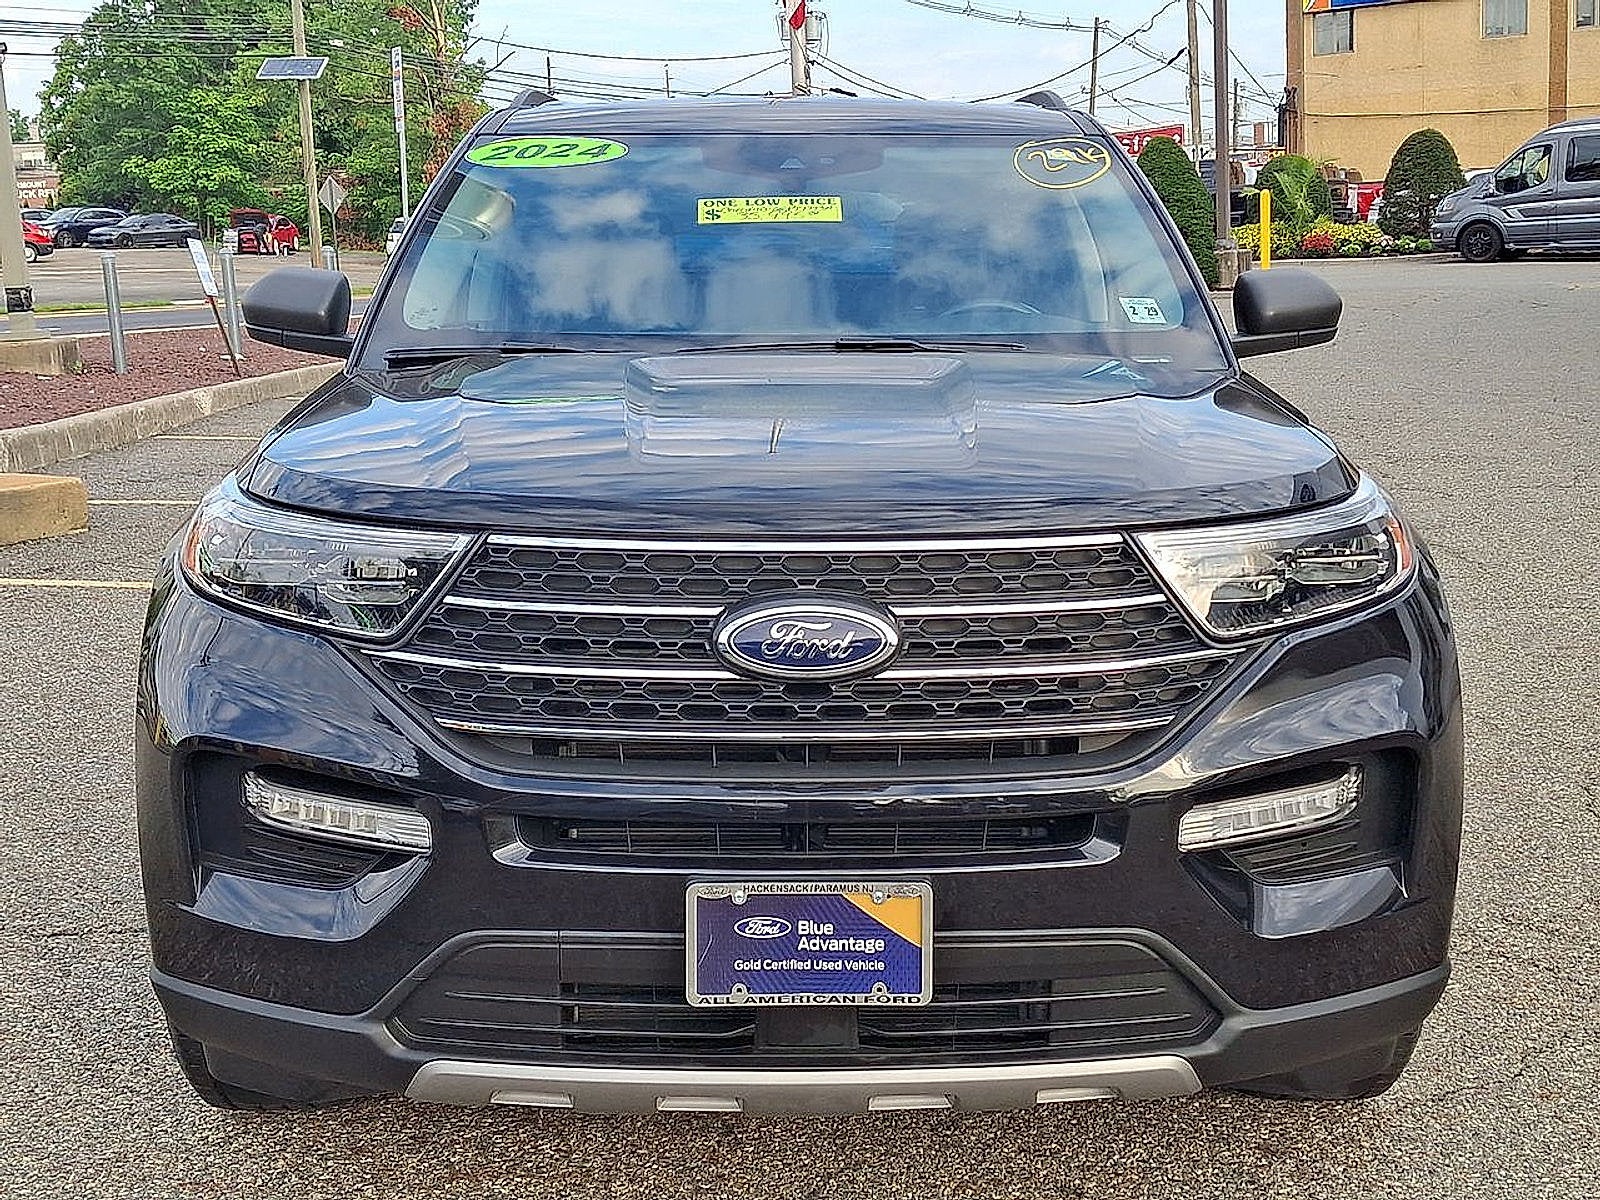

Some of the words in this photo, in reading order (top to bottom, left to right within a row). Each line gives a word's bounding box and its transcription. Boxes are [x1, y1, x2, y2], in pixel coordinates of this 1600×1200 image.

[479, 143, 612, 161] 2024
[703, 199, 737, 208] ONE
[745, 199, 780, 207] LOW
[788, 197, 837, 206] PRICE
[1129, 306, 1138, 315] 2
[761, 620, 855, 660] Ford
[862, 884, 874, 893] NJ
[744, 919, 781, 935] Ford
[797, 919, 834, 935] Blue
[797, 936, 885, 953] Advantage
[734, 959, 761, 971] Gold
[763, 959, 810, 971] Certified
[813, 959, 842, 971] Used
[844, 959, 885, 971] Vehicle
[699, 995, 735, 1005] ALL
[747, 994, 862, 1005] AMERICAN
[865, 994, 921, 1005] FORD
